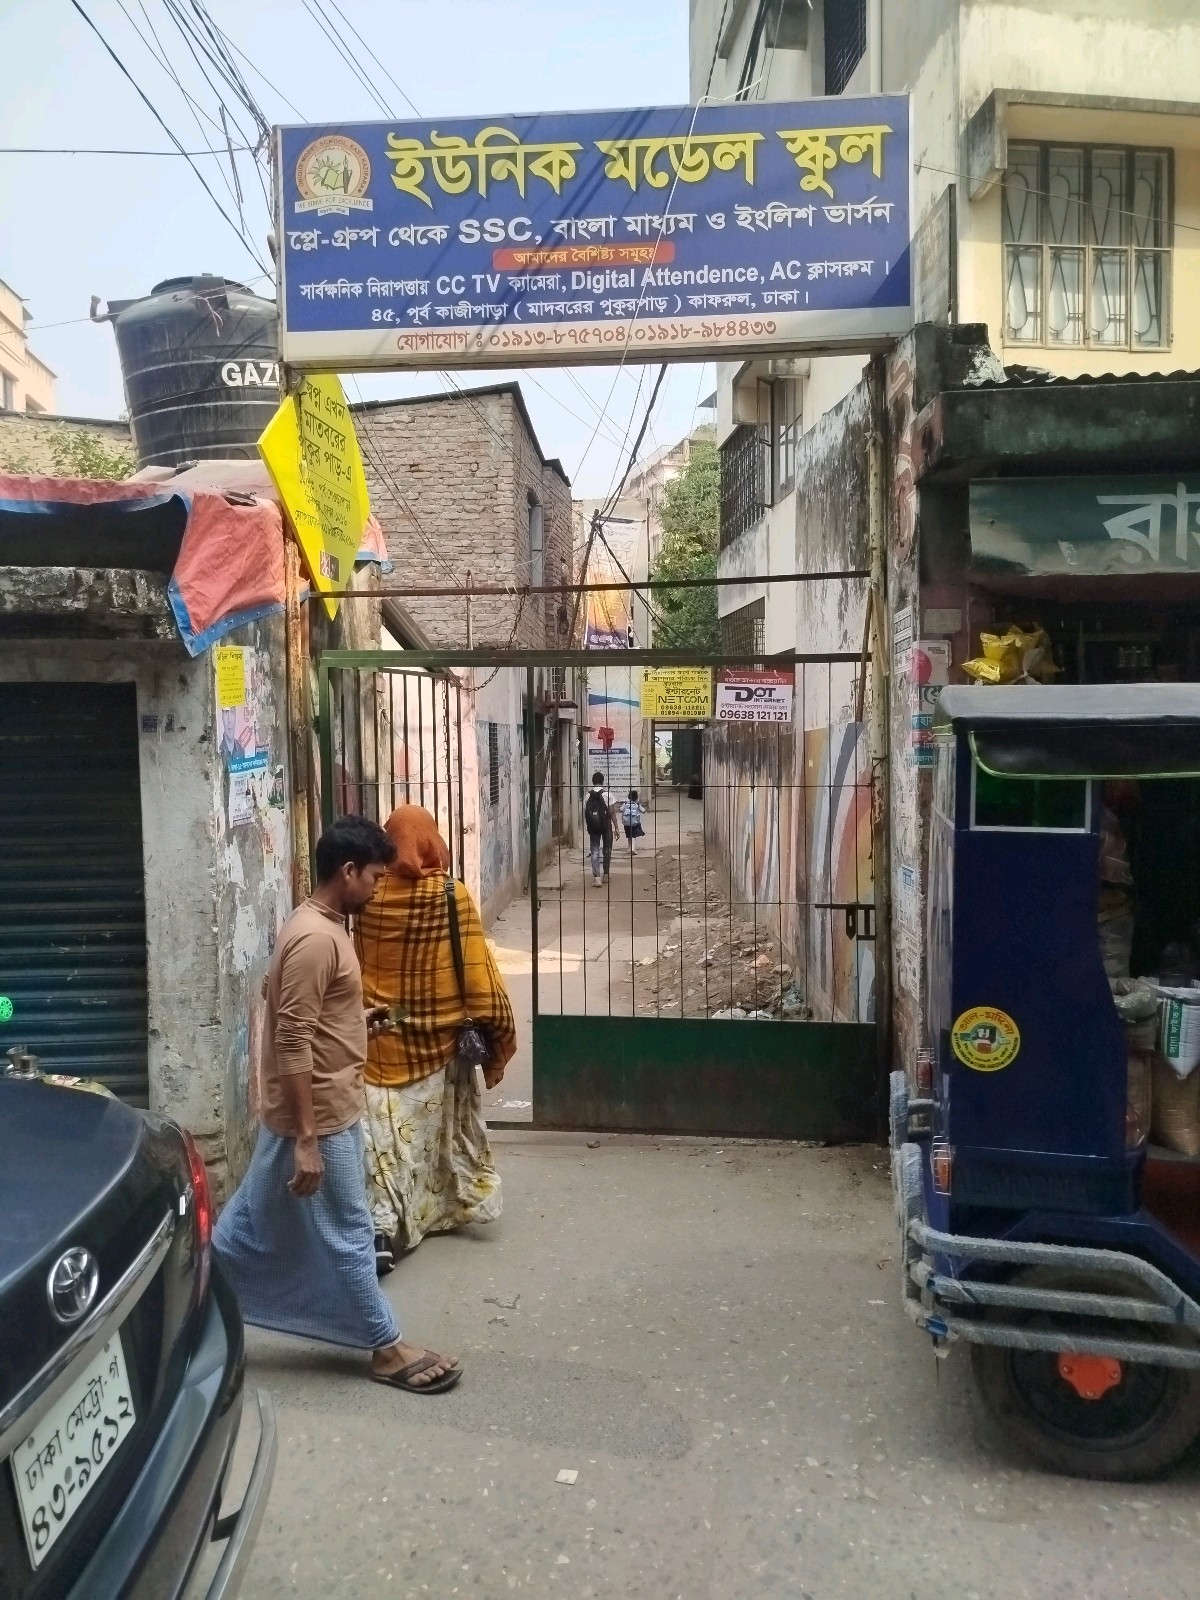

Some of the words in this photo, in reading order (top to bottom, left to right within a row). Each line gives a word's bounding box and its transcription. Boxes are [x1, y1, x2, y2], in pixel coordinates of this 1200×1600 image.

[384, 127, 584, 209] ইউনিক
[594, 132, 765, 192] মডেল
[776, 125, 893, 199] স্কুল
[287, 226, 381, 251] প্লে-গ্রুপ
[388, 223, 450, 247] থেকে
[458, 217, 542, 245] SSC,
[550, 215, 618, 240] বাংলা
[622, 213, 698, 236] মাধ্যম
[706, 212, 727, 230] ও
[734, 202, 817, 232] ইংলিশ
[822, 196, 895, 225] ভার্সন
[513, 251, 568, 264] আমাদের
[571, 245, 615, 262] বৈশিষ্ট্য
[366, 277, 430, 297] নিরাপত্তায়
[507, 273, 567, 293] ক্যামেরা,
[571, 268, 635, 294] Digital
[641, 265, 765, 287] Attendence,
[769, 260, 801, 281] AC
[806, 260, 874, 280] ক্লাসরুম
[371, 308, 400, 325] ৪৫,
[406, 301, 432, 325] পূর্ব
[434, 300, 509, 320] কাজীপাড়া
[686, 293, 756, 309] কাফরুল,
[397, 330, 470, 351] যোগাযোগ
[1096, 481, 1200, 564] রা
[658, 695, 709, 704] NETCOM
[664, 686, 702, 696] ইন্টারনেট
[724, 685, 777, 702] DOT
[719, 709, 755, 720] 09638
[25, 1429, 63, 1491] ঢাকা
